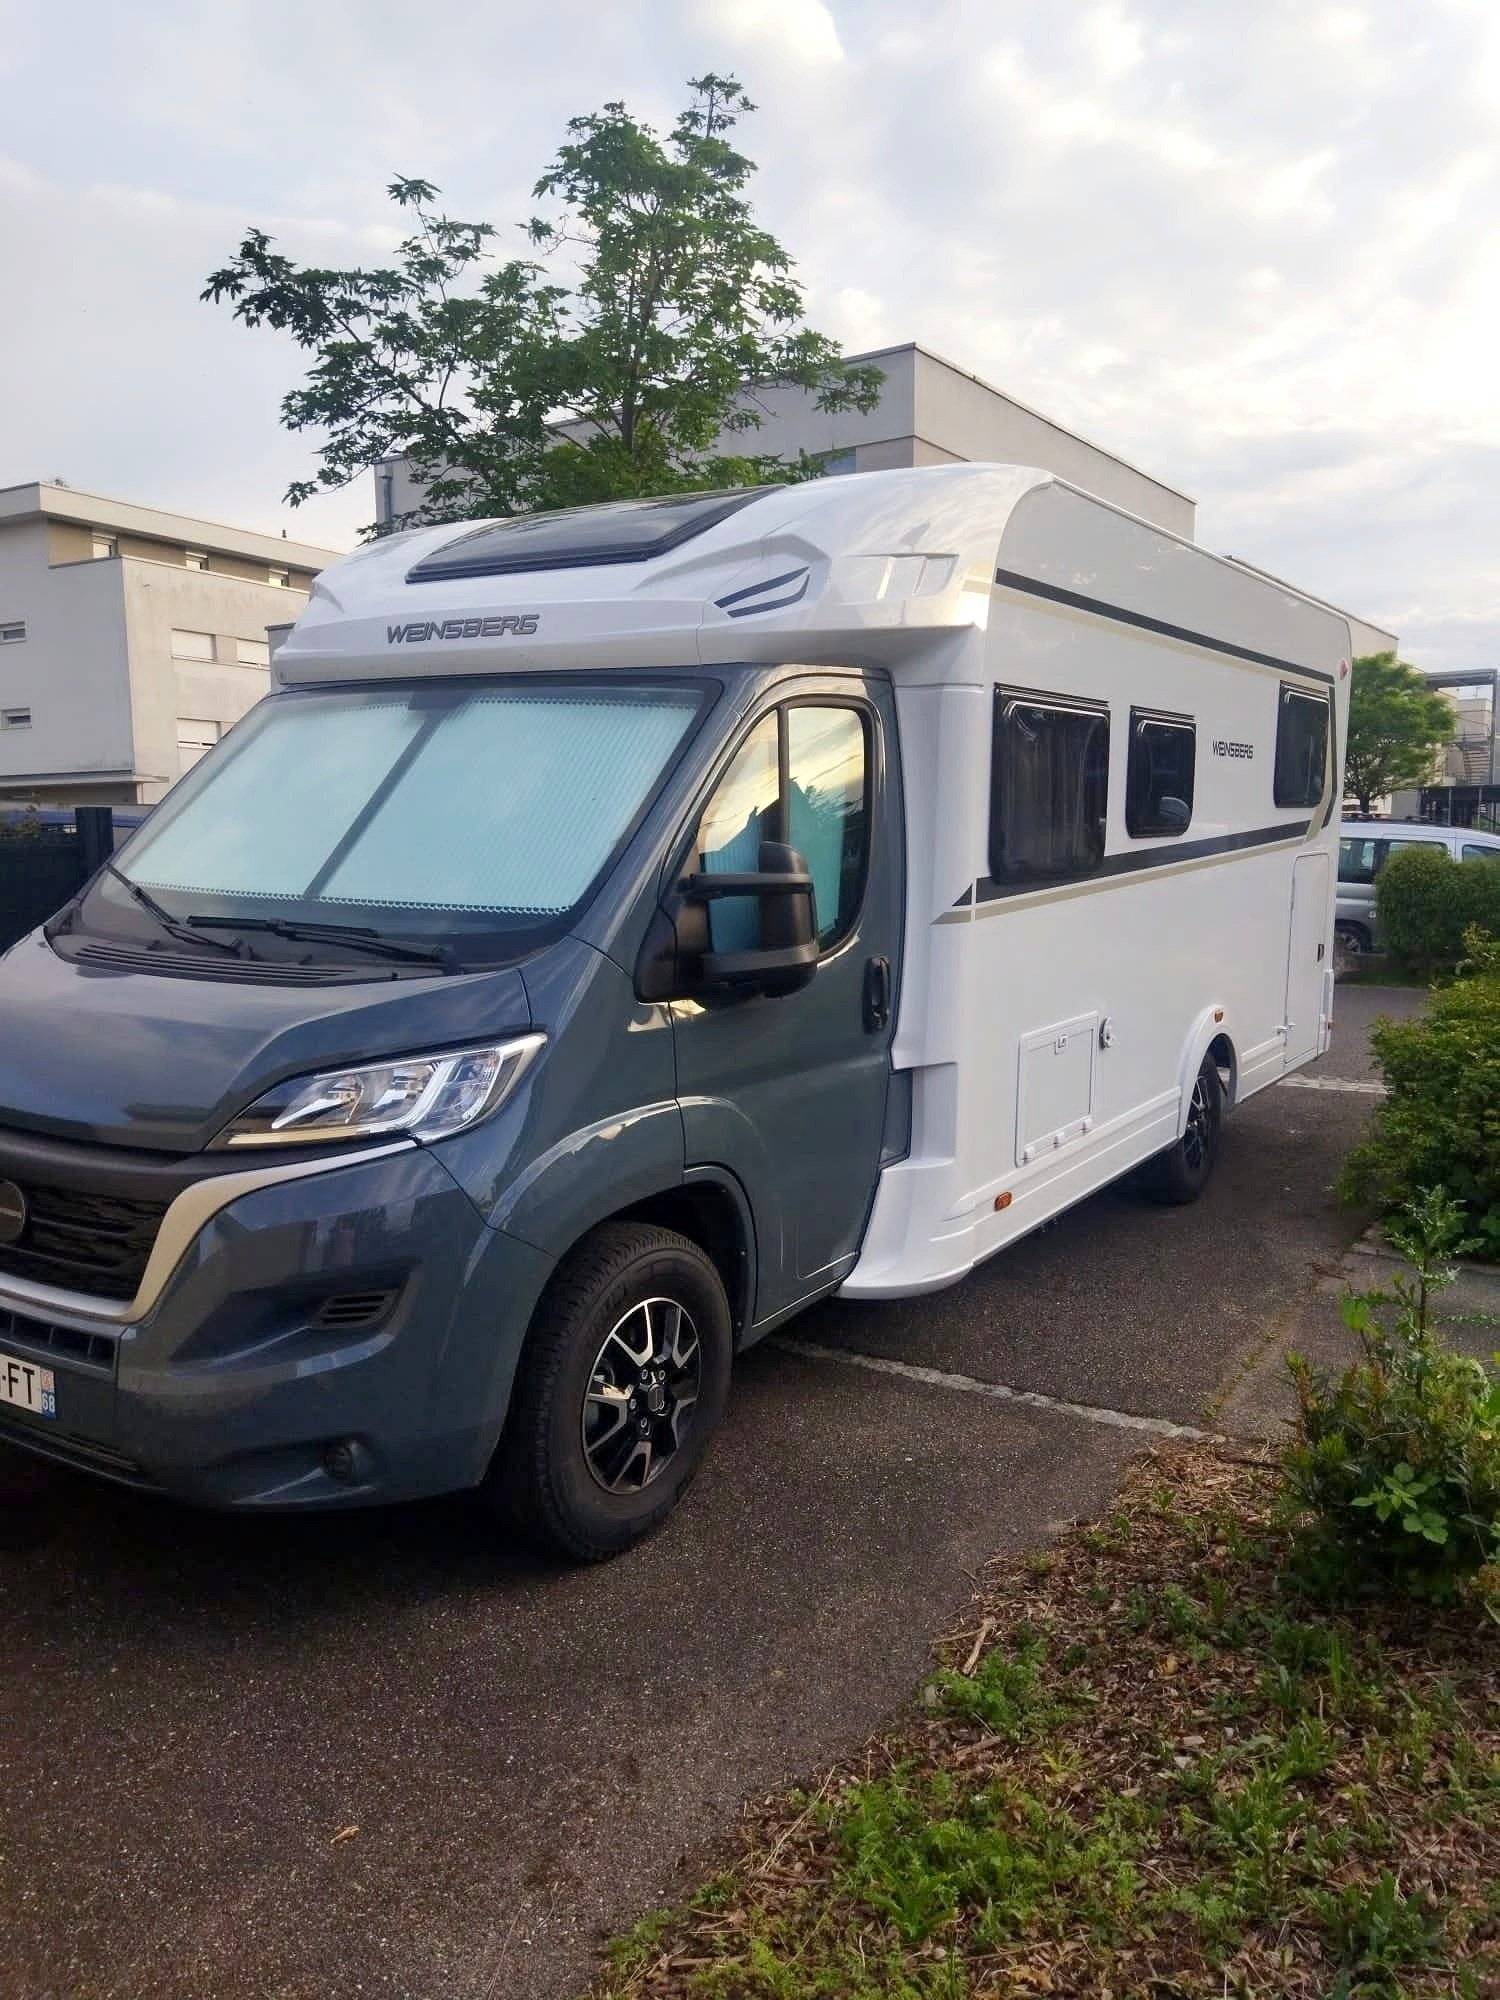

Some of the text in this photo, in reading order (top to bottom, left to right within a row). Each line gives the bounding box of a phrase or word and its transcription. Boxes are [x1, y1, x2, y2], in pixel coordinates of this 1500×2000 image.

[387, 614, 540, 644] WEINSBERG
[1212, 740, 1254, 759] WEINSBERG
[41, 1392, 55, 1413] 68
